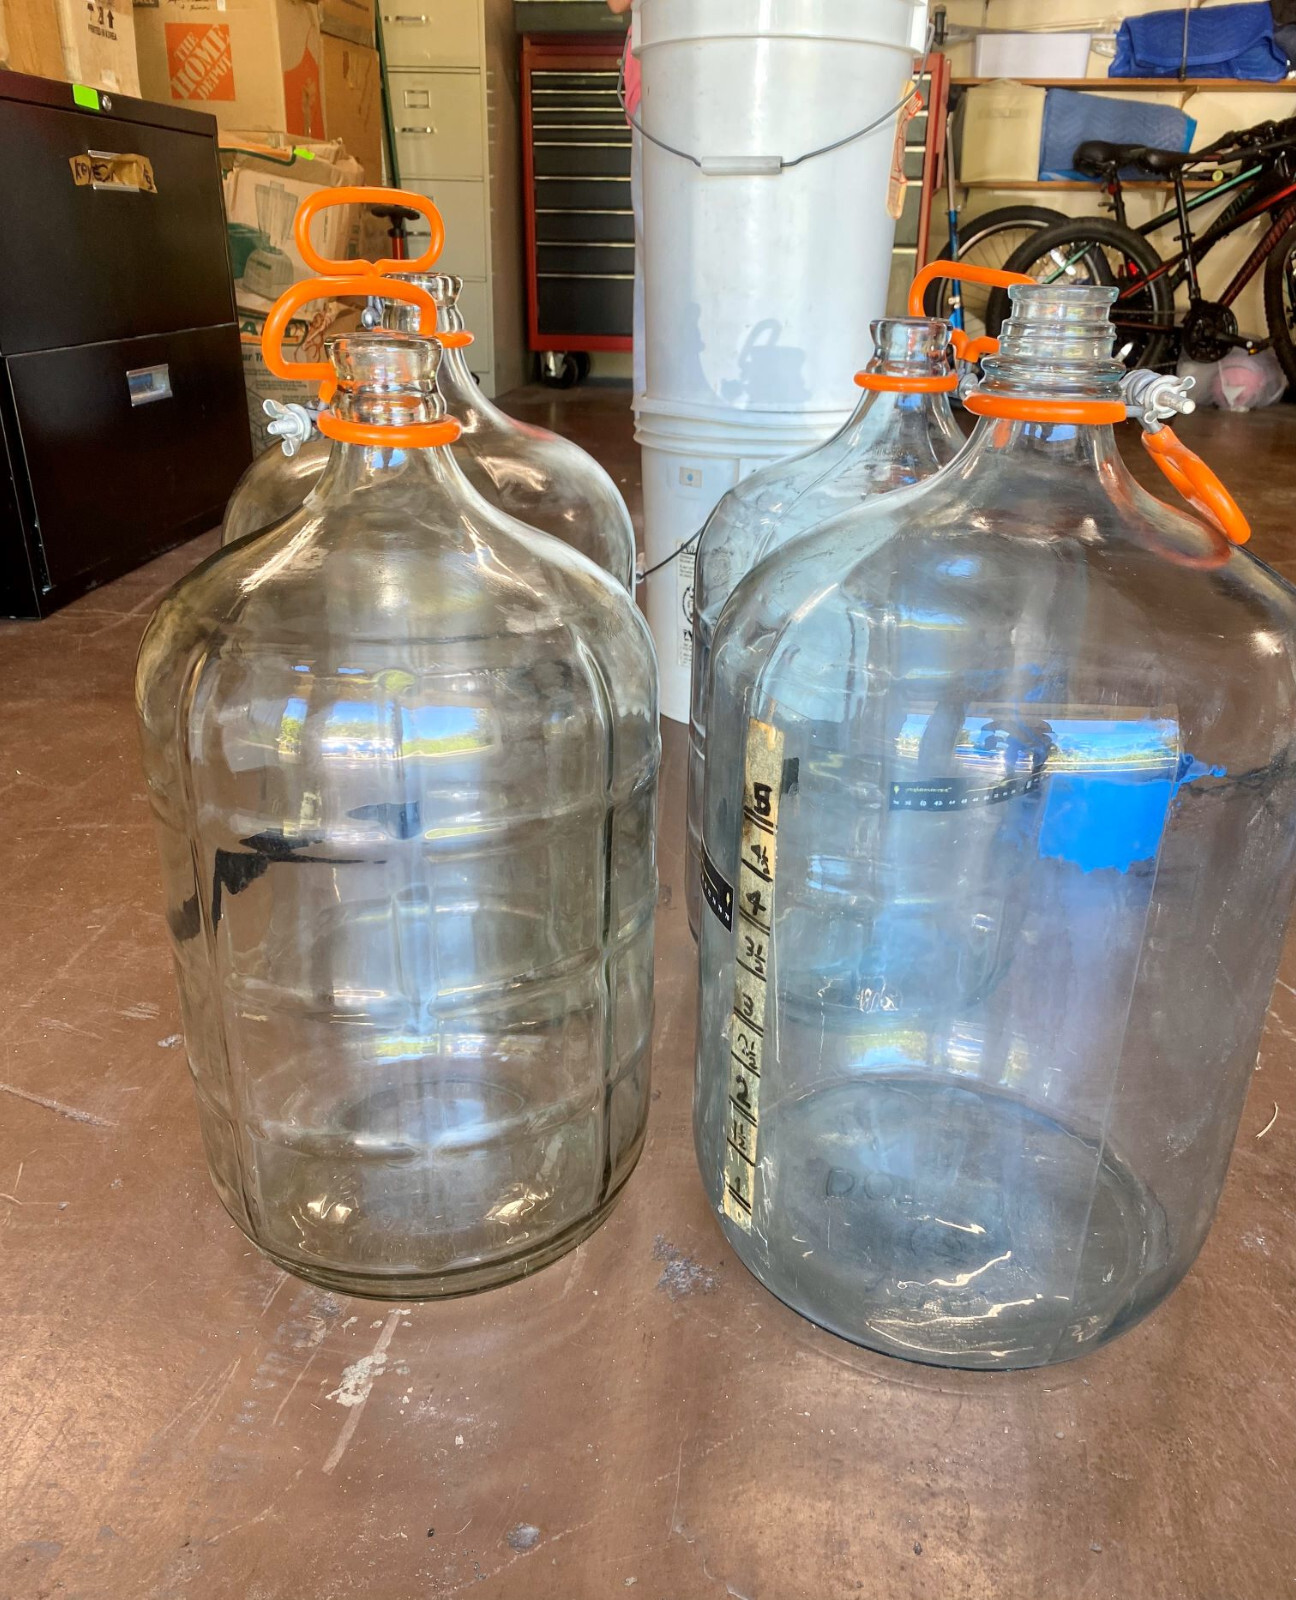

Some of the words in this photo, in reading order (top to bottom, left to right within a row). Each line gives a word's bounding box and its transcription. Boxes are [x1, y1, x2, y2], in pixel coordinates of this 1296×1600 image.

[171, 24, 229, 98] HOME
[174, 32, 199, 61] THE
[196, 53, 231, 99] DEPOT
[746, 889, 767, 916] 4
[742, 992, 755, 1017] 3
[736, 1074, 752, 1110] 2
